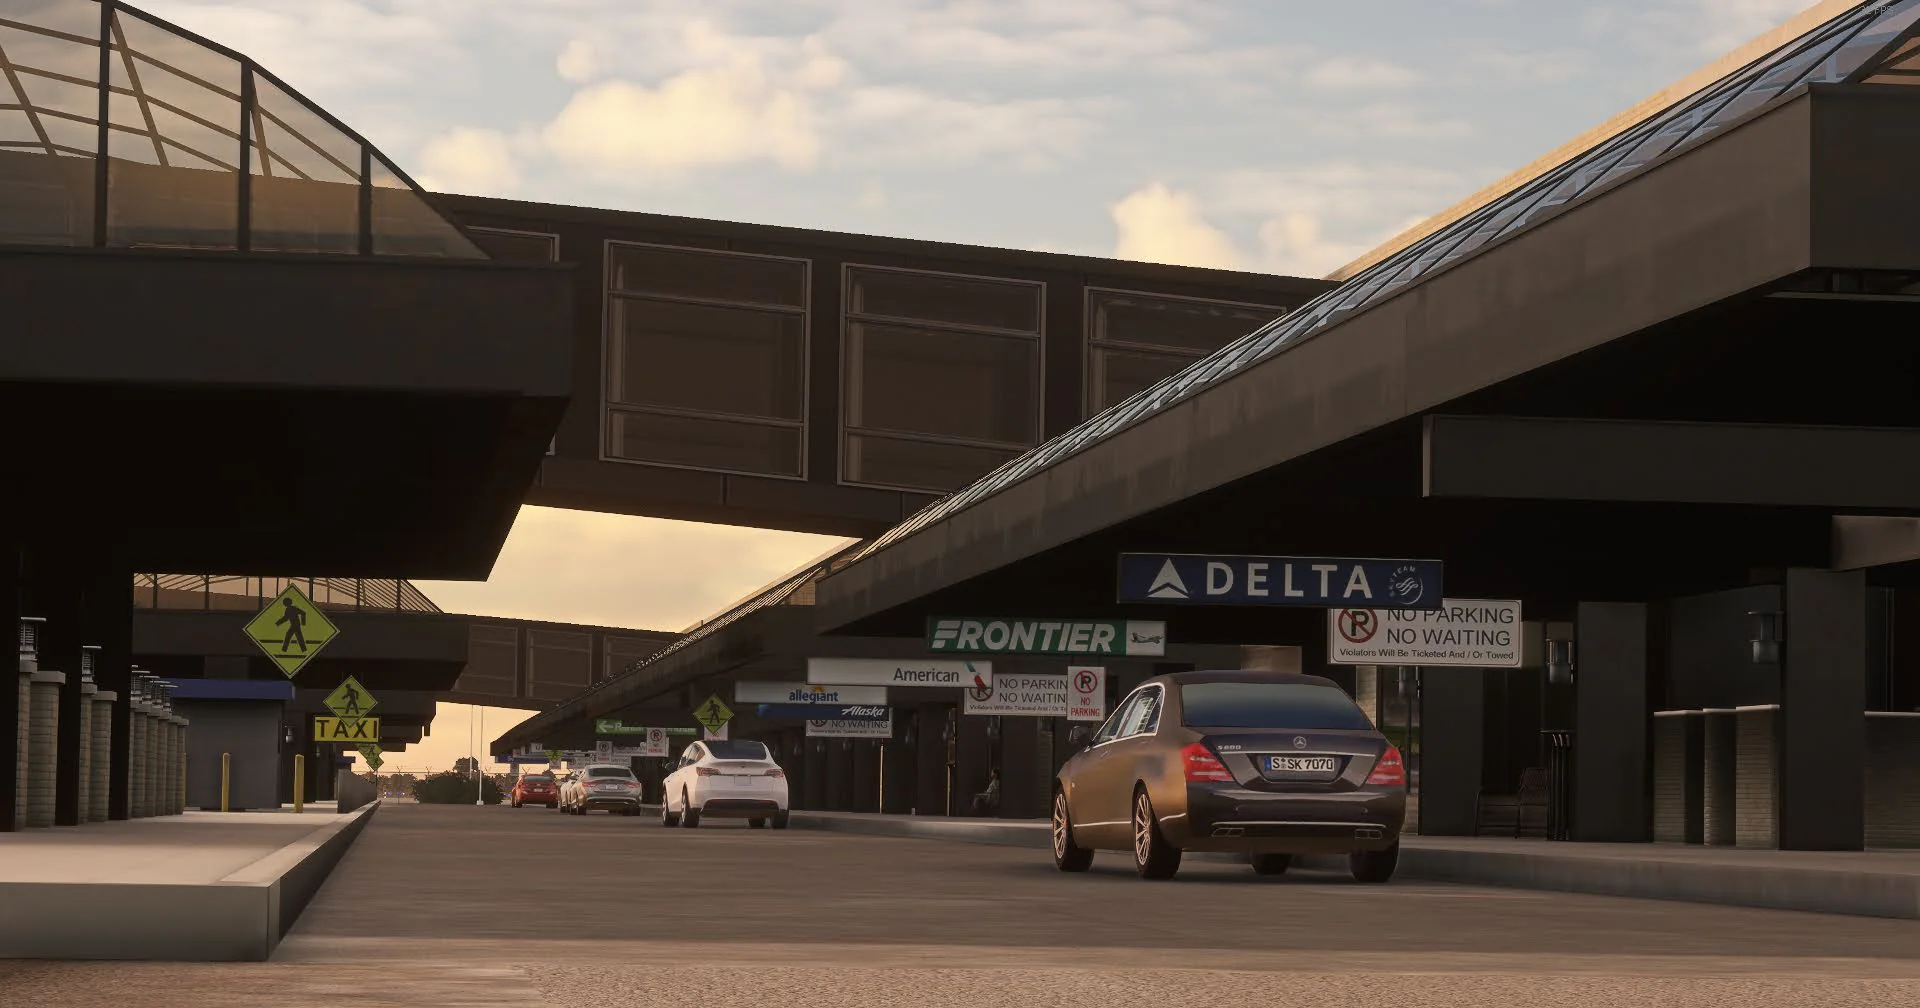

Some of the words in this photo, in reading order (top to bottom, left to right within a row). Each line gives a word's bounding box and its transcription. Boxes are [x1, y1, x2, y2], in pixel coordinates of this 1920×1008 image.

[1206, 563, 1373, 599] DELTA
[1387, 609, 1417, 622] NO
[1424, 607, 1514, 624] PARKING
[932, 620, 1116, 652] FRONTIER
[1387, 628, 1417, 645] NO
[1422, 628, 1511, 646] WAITING
[1339, 648, 1377, 657] Violators
[1378, 648, 1396, 657] Will
[1411, 649, 1447, 658] Ticketed
[1448, 651, 1465, 659] And
[1472, 651, 1484, 659] Or
[1486, 651, 1514, 660] Towed
[893, 668, 960, 683] American
[999, 678, 1018, 689] NO
[1022, 679, 1067, 690] PARKIN
[789, 689, 839, 704] allegiant
[999, 692, 1018, 703] NO
[1021, 693, 1067, 704] WAITIN
[1080, 697, 1090, 706] NO
[841, 706, 885, 717] Alaska
[1070, 707, 1100, 717] PARKING
[316, 720, 377, 738] TAXI
[831, 720, 846, 728] NO
[848, 720, 888, 729] WAITING
[1305, 759, 1333, 770] 7070
